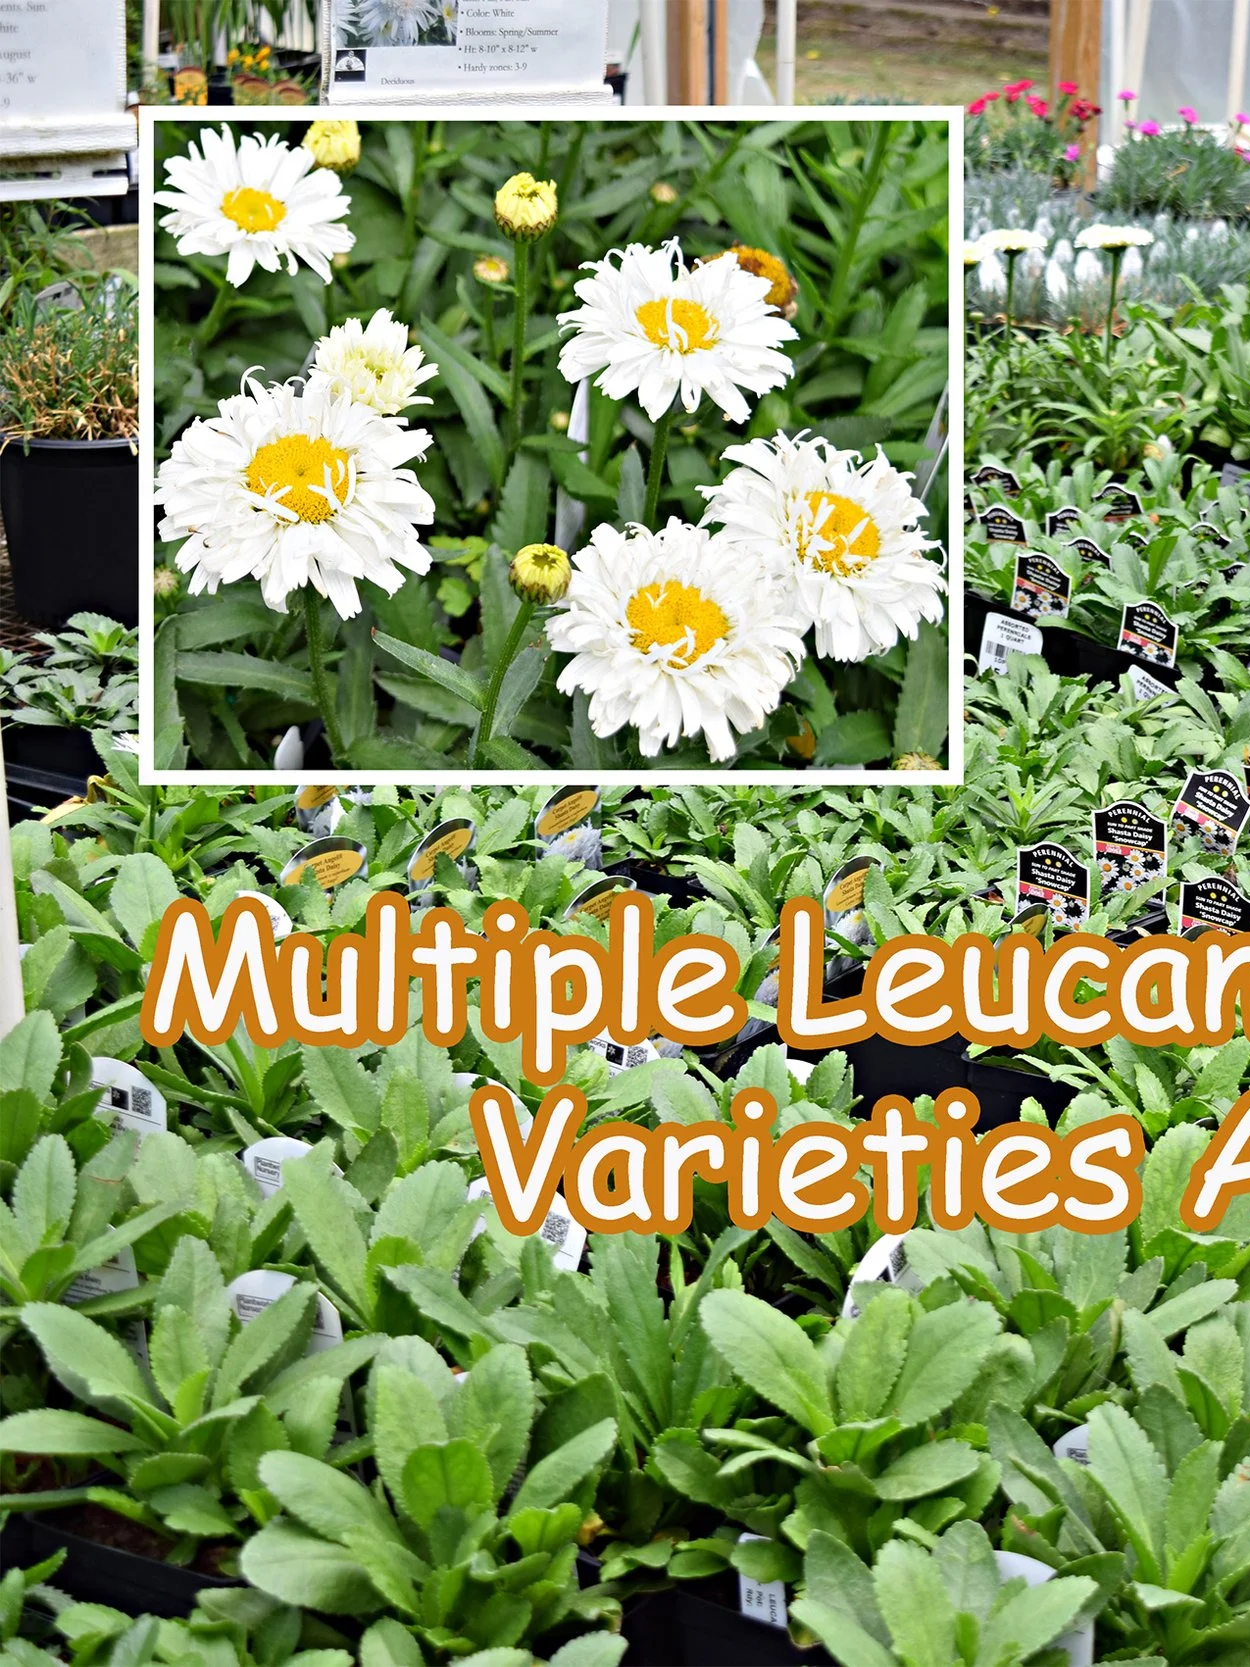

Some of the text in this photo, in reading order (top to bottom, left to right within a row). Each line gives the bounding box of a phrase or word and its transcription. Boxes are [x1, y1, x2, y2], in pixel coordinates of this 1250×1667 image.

[493, 9, 515, 17] White
[0, 22, 19, 33] hite
[466, 28, 497, 37] Blooms:
[464, 63, 487, 73] Hardy
[380, 77, 415, 86] Deciduous
[1108, 808, 1151, 823] PERENNIAL
[1108, 828, 1153, 841] Shasta Daisy
[1032, 849, 1074, 867] PERENNIAL
[1031, 869, 1076, 886] Shasta Daisy
[1197, 883, 1240, 902] PERENNIAL
[1195, 902, 1241, 921] Shasta Daisy
